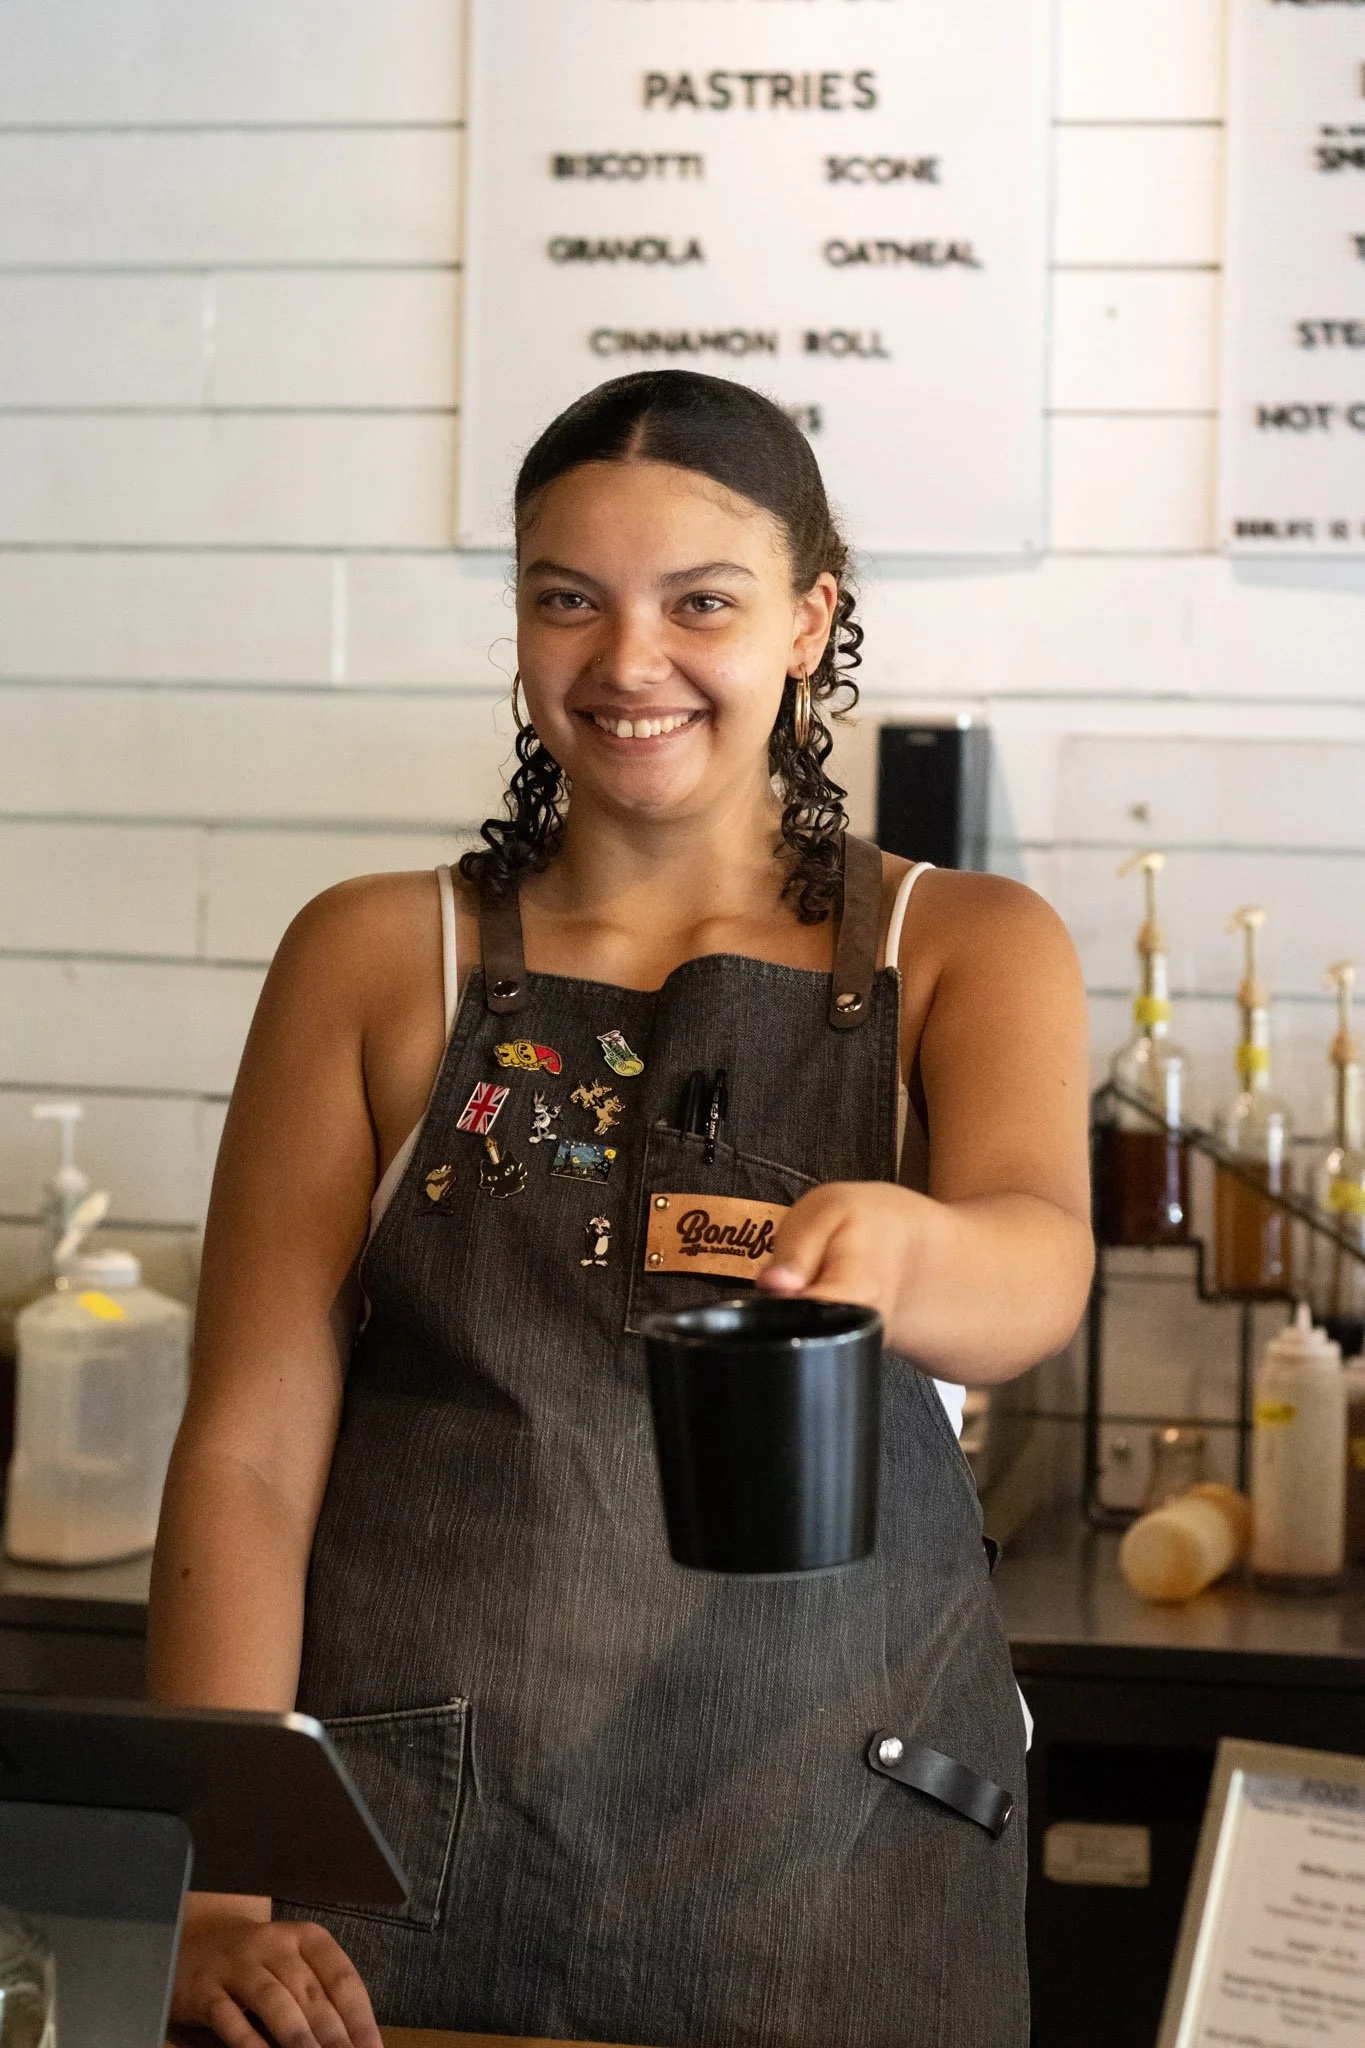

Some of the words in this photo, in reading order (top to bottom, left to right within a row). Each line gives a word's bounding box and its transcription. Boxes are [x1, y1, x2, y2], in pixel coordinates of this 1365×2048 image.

[643, 70, 877, 111] PASTRIES
[550, 152, 705, 182] BISCOTTI
[824, 154, 942, 184] SCONE
[547, 236, 704, 266] GRANOLA
[823, 239, 981, 269] OATMEAL
[588, 328, 777, 358] CINNAMON
[803, 329, 889, 359] ROLL
[1256, 403, 1334, 433] HOT
